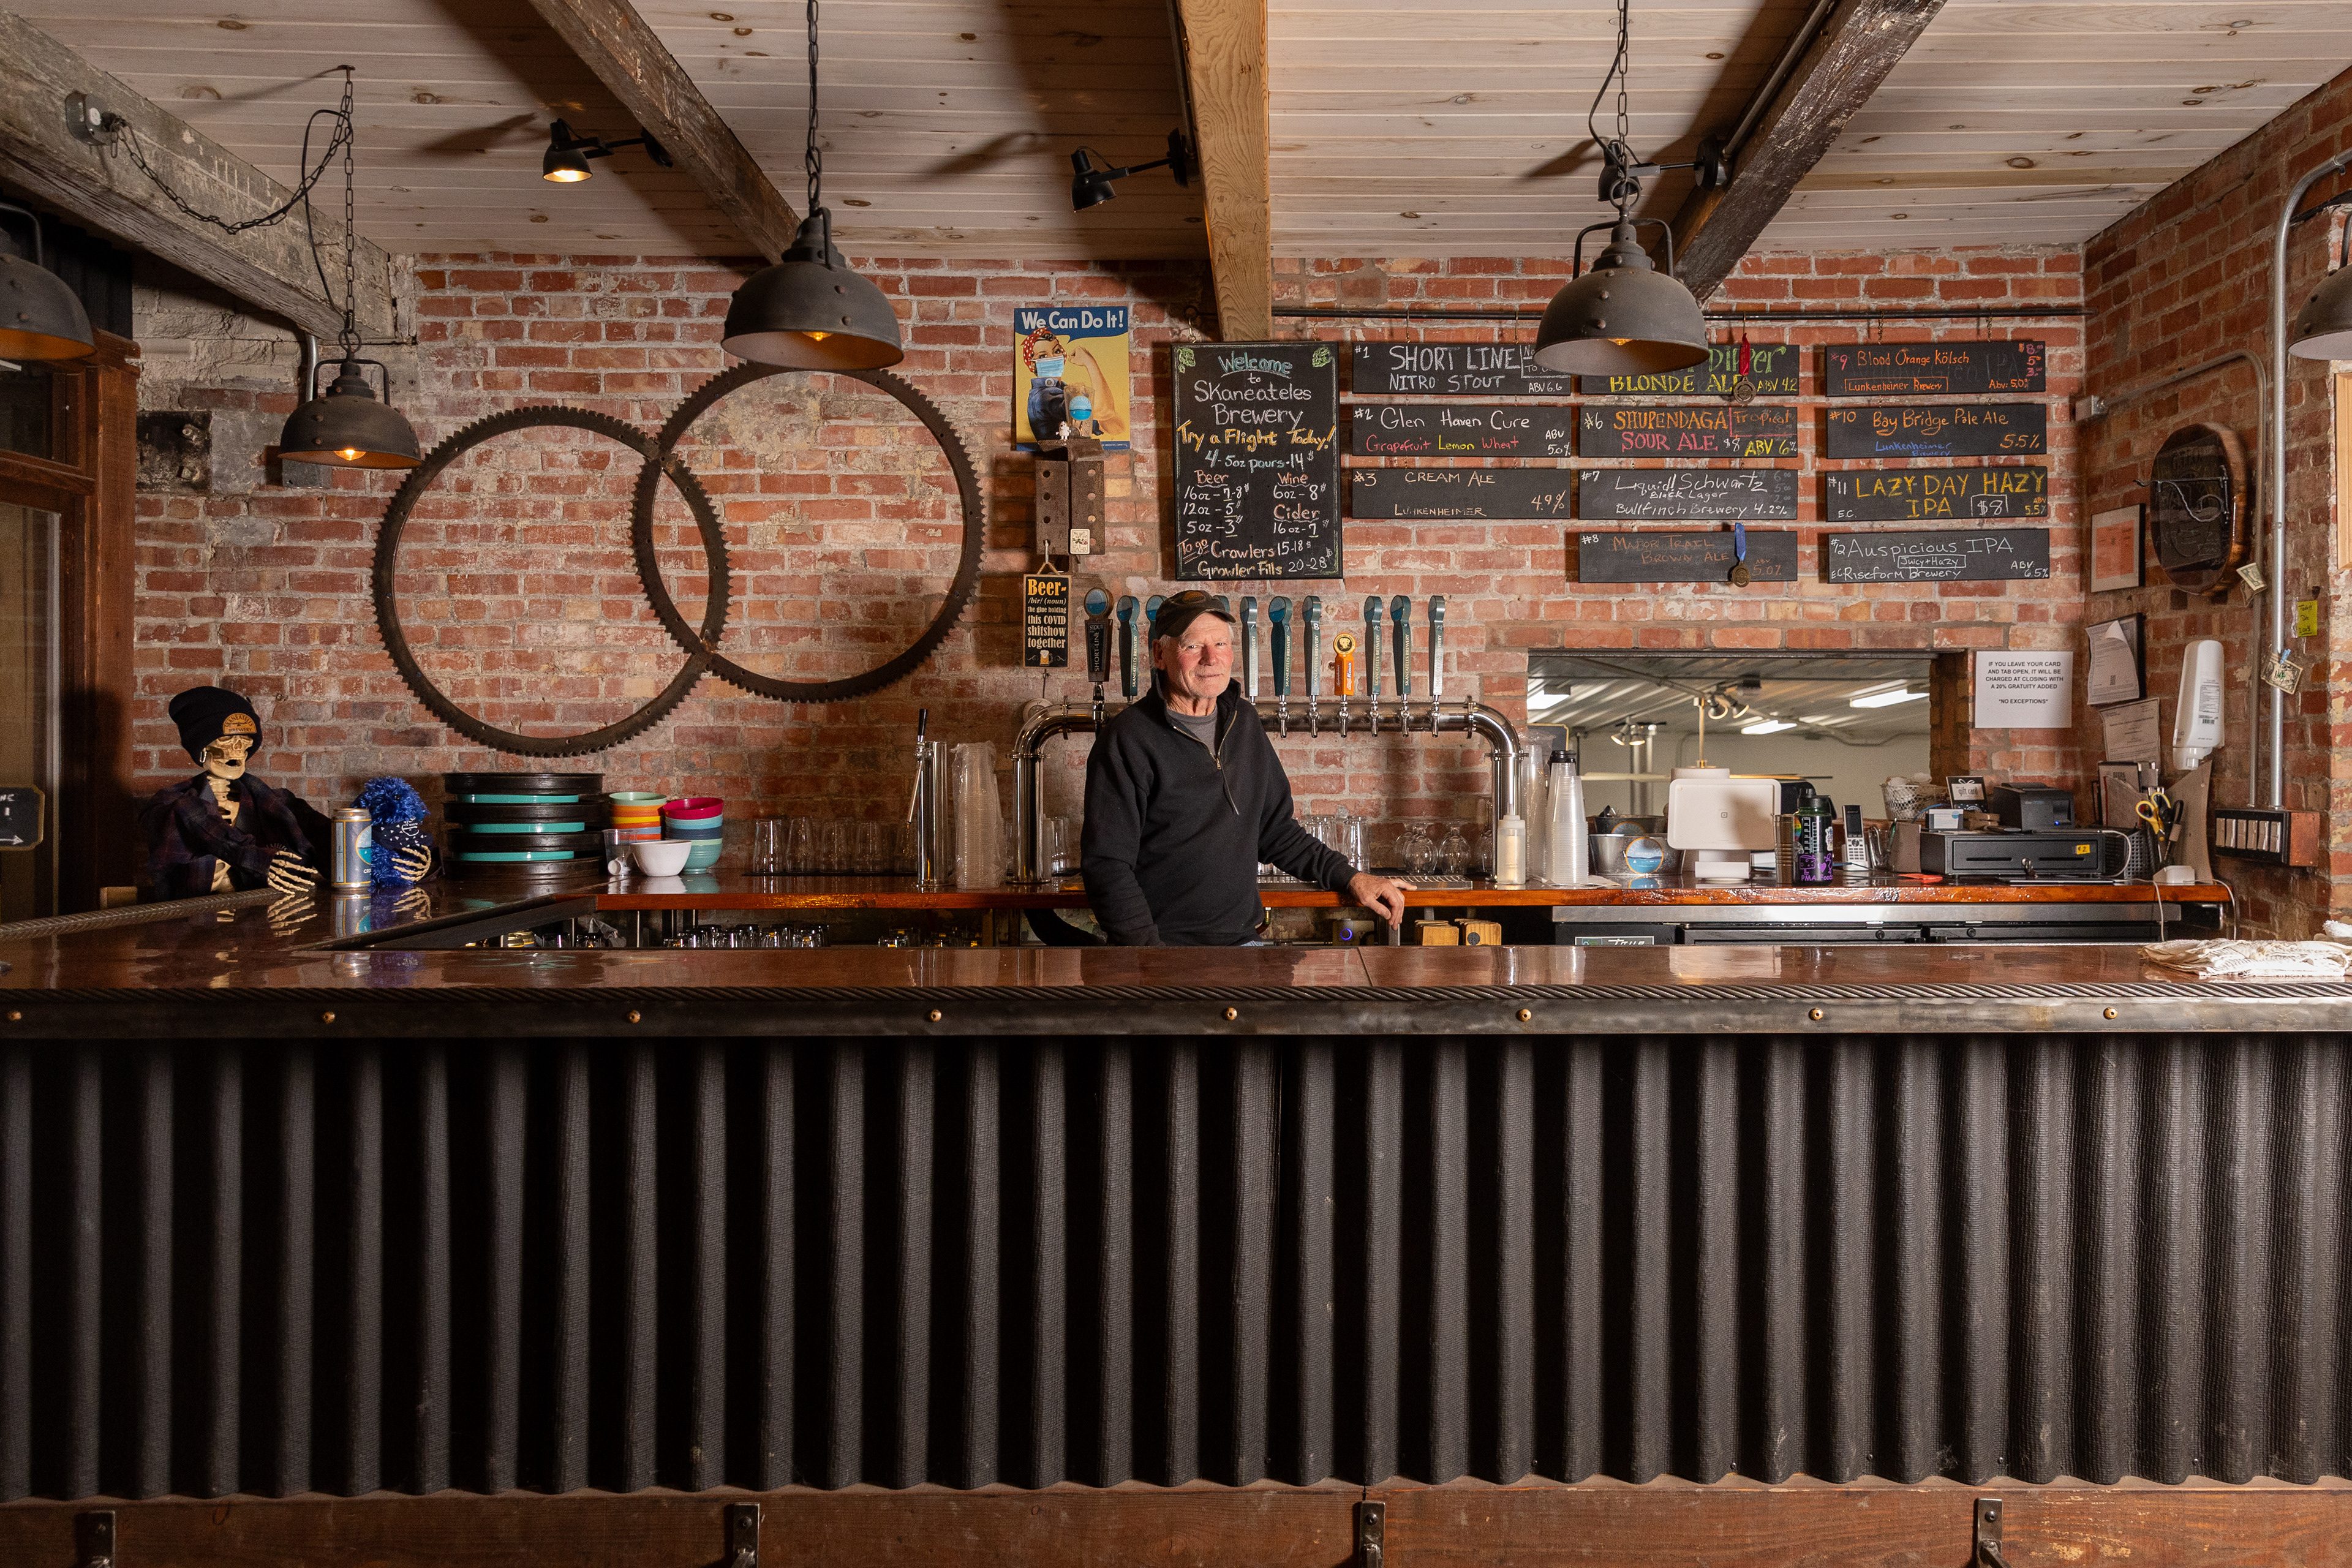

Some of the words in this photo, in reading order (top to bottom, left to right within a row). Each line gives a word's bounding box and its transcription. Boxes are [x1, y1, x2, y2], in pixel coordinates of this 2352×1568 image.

[1021, 311, 1046, 329] We
[1049, 311, 1078, 329] Can
[1081, 311, 1103, 329] Do
[1106, 310, 1124, 328] It!
[1217, 350, 1293, 374] Welcome
[1354, 346, 1370, 359] #1
[1389, 345, 1461, 372] SHORT
[1466, 345, 1521, 371] LINE
[1830, 352, 1849, 371] #9
[1857, 350, 1891, 366] Blood
[1895, 348, 1931, 366] Orange
[1935, 350, 1970, 365] Kölsch
[1247, 372, 1261, 383] to
[1389, 373, 1436, 391] NITRO
[1447, 374, 1506, 392] STOUT
[1610, 375, 1695, 393] BLONDE
[1757, 378, 1778, 392] ABV
[1913, 377, 1943, 391] Brewery
[1528, 382, 1545, 393] ABV
[1547, 382, 1562, 392] 6.6
[1211, 403, 1303, 431] Brewery
[1353, 408, 1374, 421] #2
[1380, 407, 1425, 429] Glen
[1440, 409, 1482, 428] Haven
[1490, 410, 1531, 431] Cure
[1584, 412, 1604, 430] #6
[1733, 409, 1790, 426] Tropical
[1829, 411, 1856, 423] #10
[1873, 410, 1898, 435] Bay
[1903, 408, 1950, 435] Bridge
[1954, 407, 1978, 425] Pale
[1983, 409, 2009, 425] Ale
[1176, 420, 1205, 453] Try
[1210, 434, 1221, 445] a
[1224, 429, 1278, 453] Flight
[1286, 425, 1336, 451] Today!
[1366, 434, 1431, 453] Grapefruit
[1438, 434, 1475, 450] Lemon
[1482, 435, 1520, 450] Wheat
[1545, 429, 1565, 440] ABV
[1621, 431, 1671, 453] SOUR
[1676, 432, 1719, 451] ALE
[1744, 439, 1774, 457] ABV
[1194, 469, 1229, 484] Beer
[1278, 472, 1309, 484] Wine
[1353, 470, 1378, 487] #3
[1404, 471, 1460, 483] CREAM
[1468, 470, 1496, 487] ALE
[1581, 470, 1600, 482] #7
[1828, 477, 1847, 495] #11
[1856, 475, 1915, 499] LAZY
[1924, 474, 1969, 497] DAY
[1983, 470, 2045, 495] HAZY
[1688, 491, 1728, 503] Lager
[1273, 503, 1320, 519] Cider
[1616, 502, 1686, 516] Bullfinch
[1690, 503, 1747, 519] Brewery
[1906, 497, 1953, 518] IPA
[1979, 500, 2003, 516] $8
[1177, 538, 1193, 556] To
[1196, 539, 1208, 555] go
[1211, 541, 1276, 559] Crowlers
[1278, 540, 1303, 556] 15-18
[1581, 534, 1599, 545] #8
[1660, 534, 1715, 548] TRAIL
[1830, 538, 1845, 556] #12
[1847, 538, 1958, 562] Auspicious
[1966, 537, 2014, 554] IPA
[1641, 552, 1692, 565] BROWN
[1704, 551, 1730, 561] ALE
[1197, 560, 1255, 579] Growler
[1257, 560, 1283, 576] Fills
[1909, 566, 1961, 581] Brewery
[1028, 615, 1041, 624] this
[1044, 615, 1066, 625] COVID
[1027, 625, 1066, 637] shitshow
[1028, 637, 1066, 650] together
